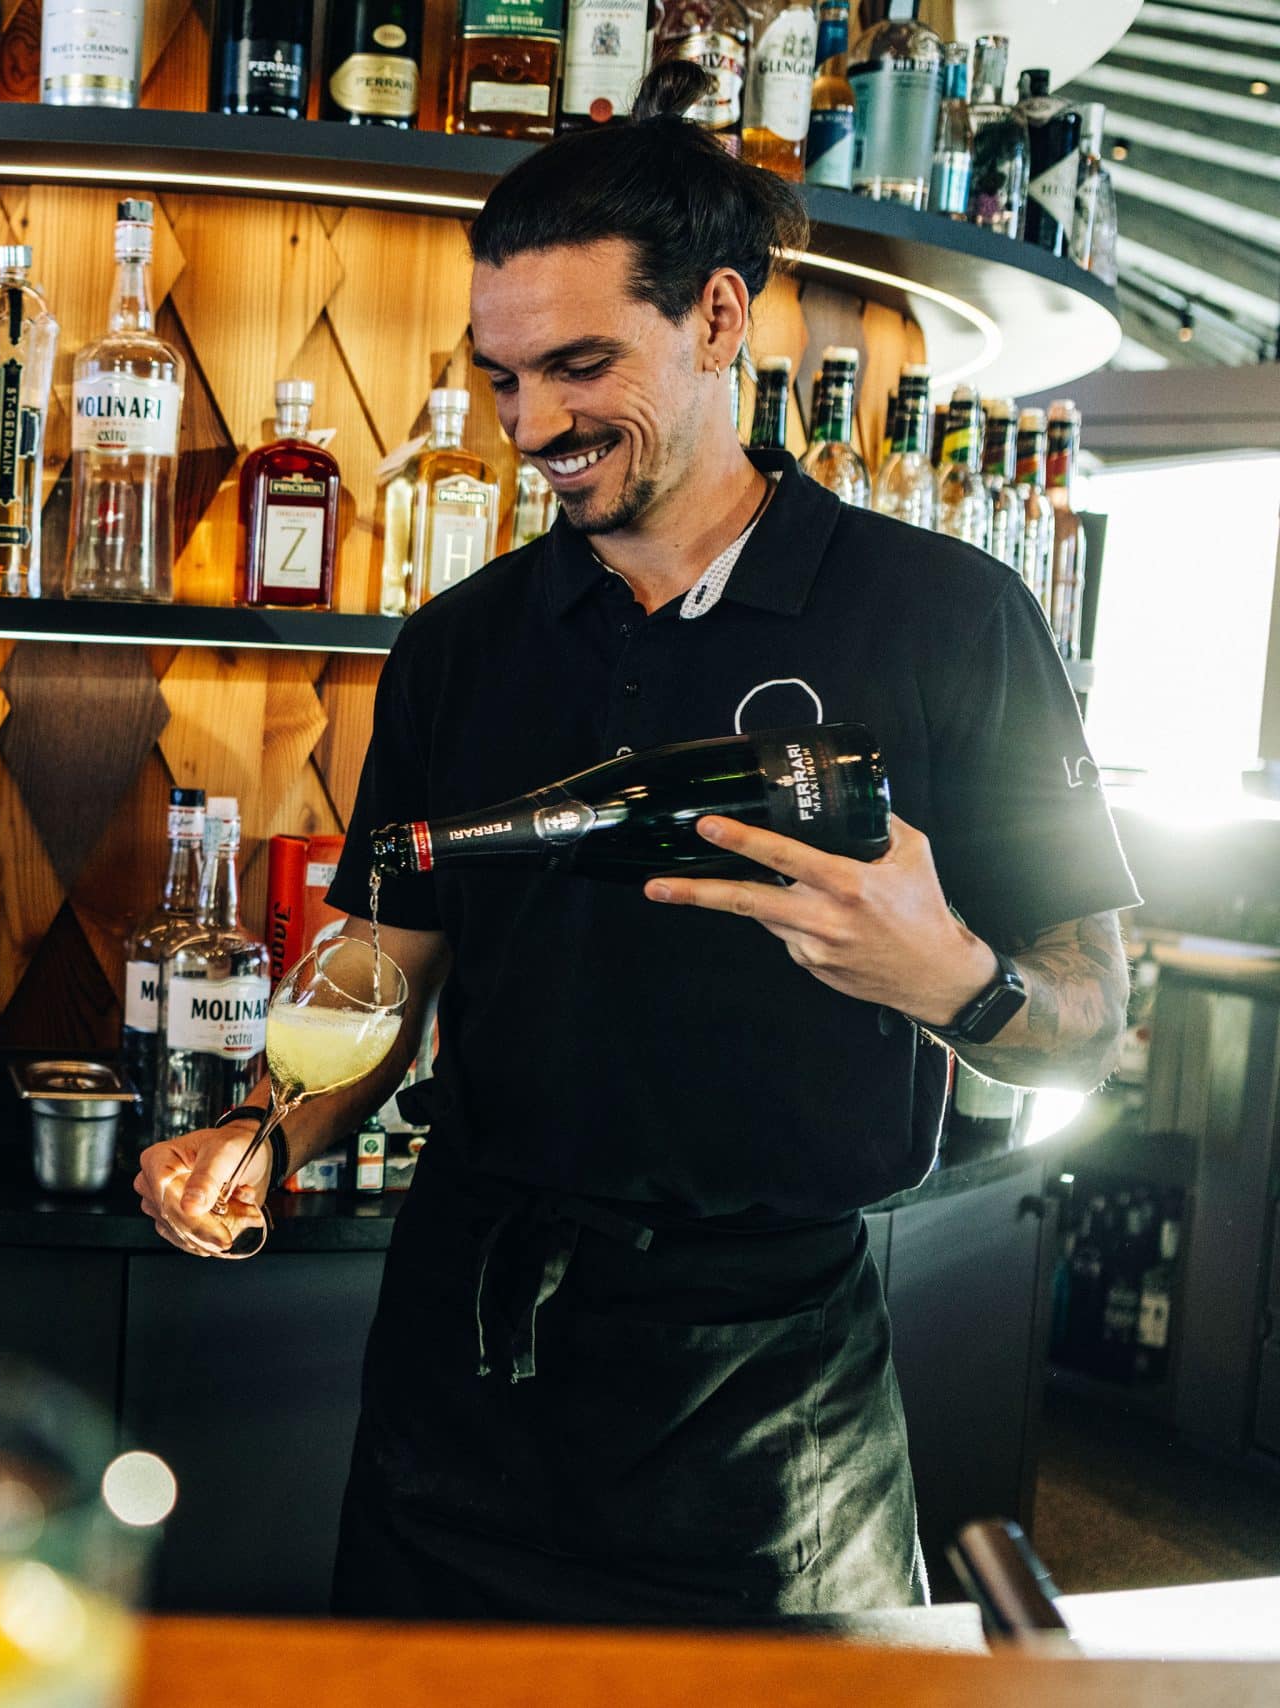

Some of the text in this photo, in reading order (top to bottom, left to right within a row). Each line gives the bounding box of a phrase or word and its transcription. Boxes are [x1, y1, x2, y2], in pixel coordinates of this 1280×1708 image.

[77, 395, 161, 419] MOLINARI
[280, 526, 307, 573] Z
[443, 534, 474, 582] H
[784, 743, 815, 821] FERRARI
[801, 747, 823, 813] MAXIMUM
[448, 820, 513, 841] FERRARI
